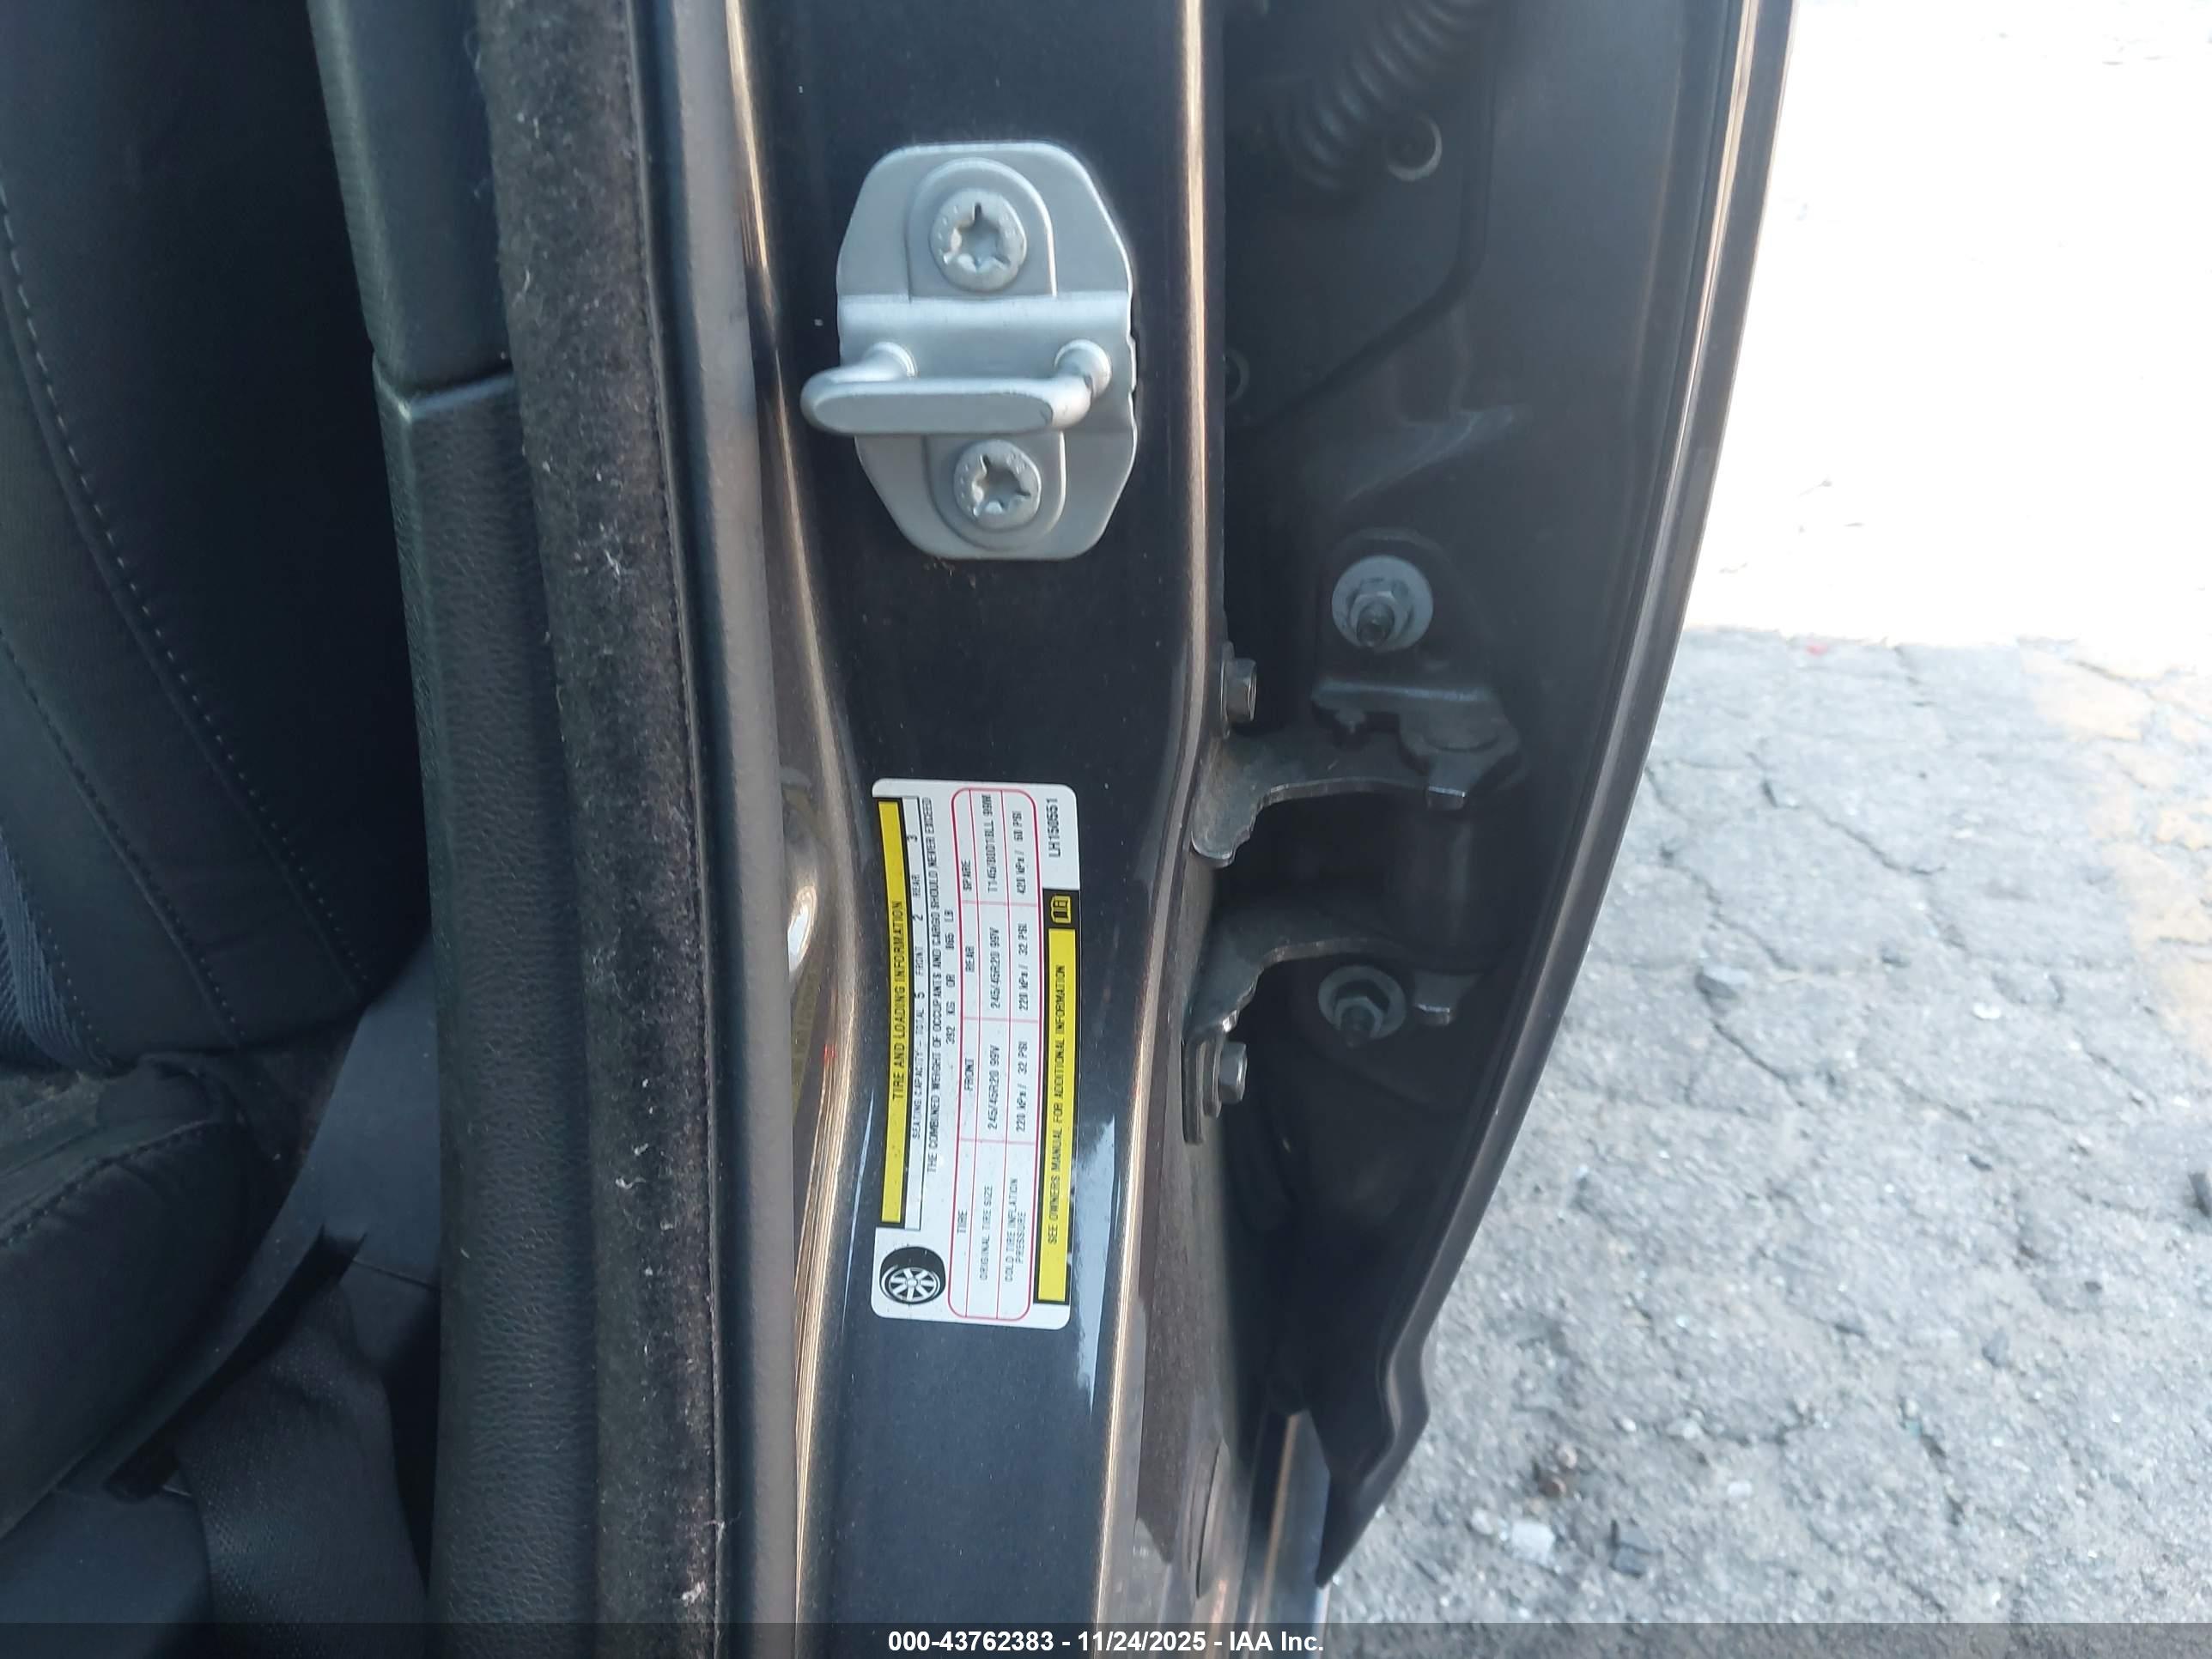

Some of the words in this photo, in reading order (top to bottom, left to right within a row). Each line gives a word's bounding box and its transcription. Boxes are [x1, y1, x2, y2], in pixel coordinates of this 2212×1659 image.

[922, 797, 934, 834] EXCEED
[1012, 811, 1023, 828] PSI
[1046, 798, 1060, 858] LH150551
[1013, 830, 1024, 842] 60
[925, 837, 937, 867] NEVER
[911, 874, 921, 898] REAR
[961, 860, 972, 891] SPARE
[928, 871, 939, 909] SHOULD
[930, 912, 941, 945] CARGO
[944, 908, 954, 922] LB
[892, 901, 905, 982] INFORMATION
[989, 927, 1000, 948] 99V
[1018, 922, 1027, 940] PSI
[915, 945, 924, 976] FRONT
[932, 948, 942, 969] AND
[965, 945, 975, 973] REAR
[1018, 942, 1028, 955] 32
[945, 974, 955, 988] OR
[990, 951, 1000, 1009] 245/45R20
[894, 987, 906, 1038] LOADING
[932, 973, 942, 1032] OCCUPANTS
[945, 1001, 955, 1016] KG
[1018, 993, 1029, 1011] 220
[1055, 965, 1066, 1034] INFORMATION
[915, 1007, 925, 1036] TOTAL
[894, 1042, 905, 1068] AND
[932, 1035, 942, 1048] OF
[989, 1045, 1000, 1066] 99V
[1018, 1041, 1028, 1059] PSI
[914, 1050, 924, 1097] CAPACITY
[931, 1051, 941, 1091] WEIGHT
[964, 1058, 975, 1091] FRONT
[1018, 1061, 1027, 1075] 32
[1054, 1037, 1065, 1099] ADDITIONAL
[892, 1072, 904, 1101] TIRE
[988, 1070, 1000, 1130] 245/45R20
[912, 1099, 921, 1139] SEATING
[928, 1095, 940, 1150] COMBINED
[1016, 1114, 1025, 1132] 220
[1054, 1103, 1063, 1123] FOR
[927, 1153, 937, 1173] THE
[1051, 1127, 1062, 1172] MANUAL
[983, 1186, 993, 1206] SIZE
[1008, 1178, 1018, 1228] INFLATION
[1049, 1176, 1060, 1219] OWNERS
[957, 1209, 967, 1234] TIRE
[982, 1208, 992, 1230] TIRE
[1006, 1231, 1016, 1251] TIRE
[1016, 1212, 1026, 1263] PRESSURE
[1048, 1224, 1058, 1244] SEE
[980, 1234, 990, 1280] ORIGINAL
[1005, 1256, 1014, 1282] COLD
